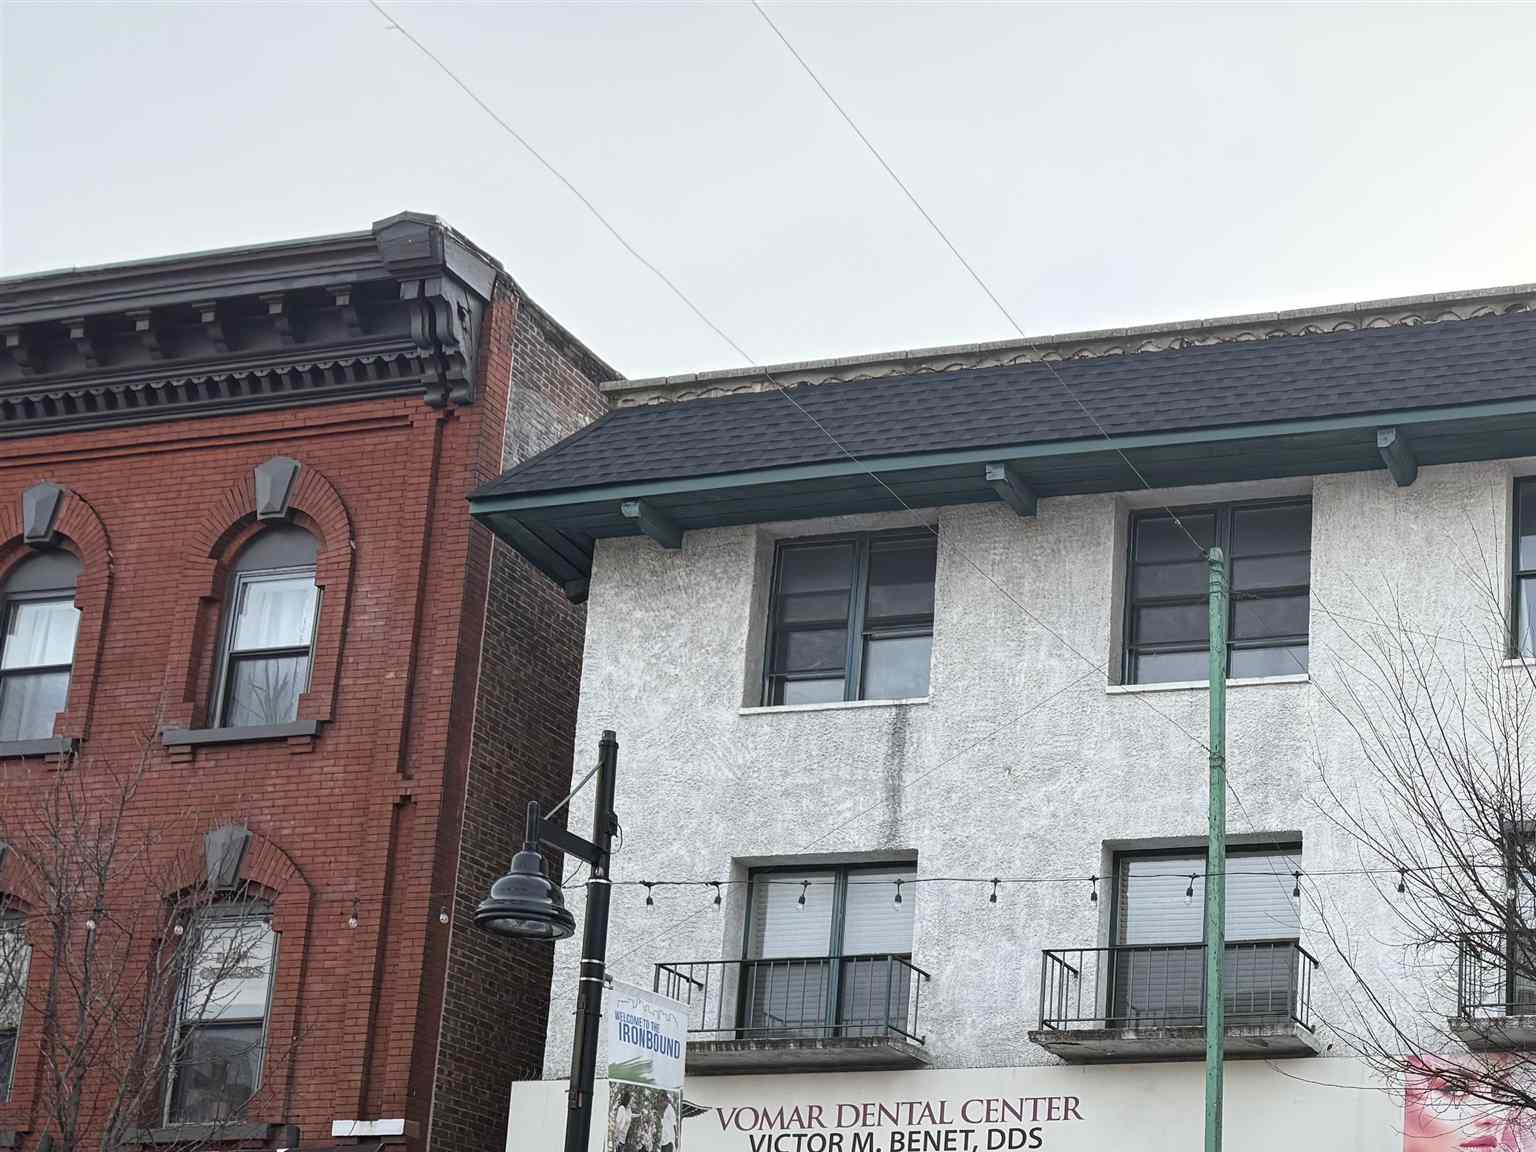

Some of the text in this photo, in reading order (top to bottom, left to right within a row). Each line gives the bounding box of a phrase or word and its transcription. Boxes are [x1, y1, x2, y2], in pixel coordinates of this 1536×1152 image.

[618, 1022, 681, 1060] IRONBOUND
[716, 1096, 1086, 1131] VOMAR DENTAL CENTER
[986, 1126, 1043, 1150] DDS
